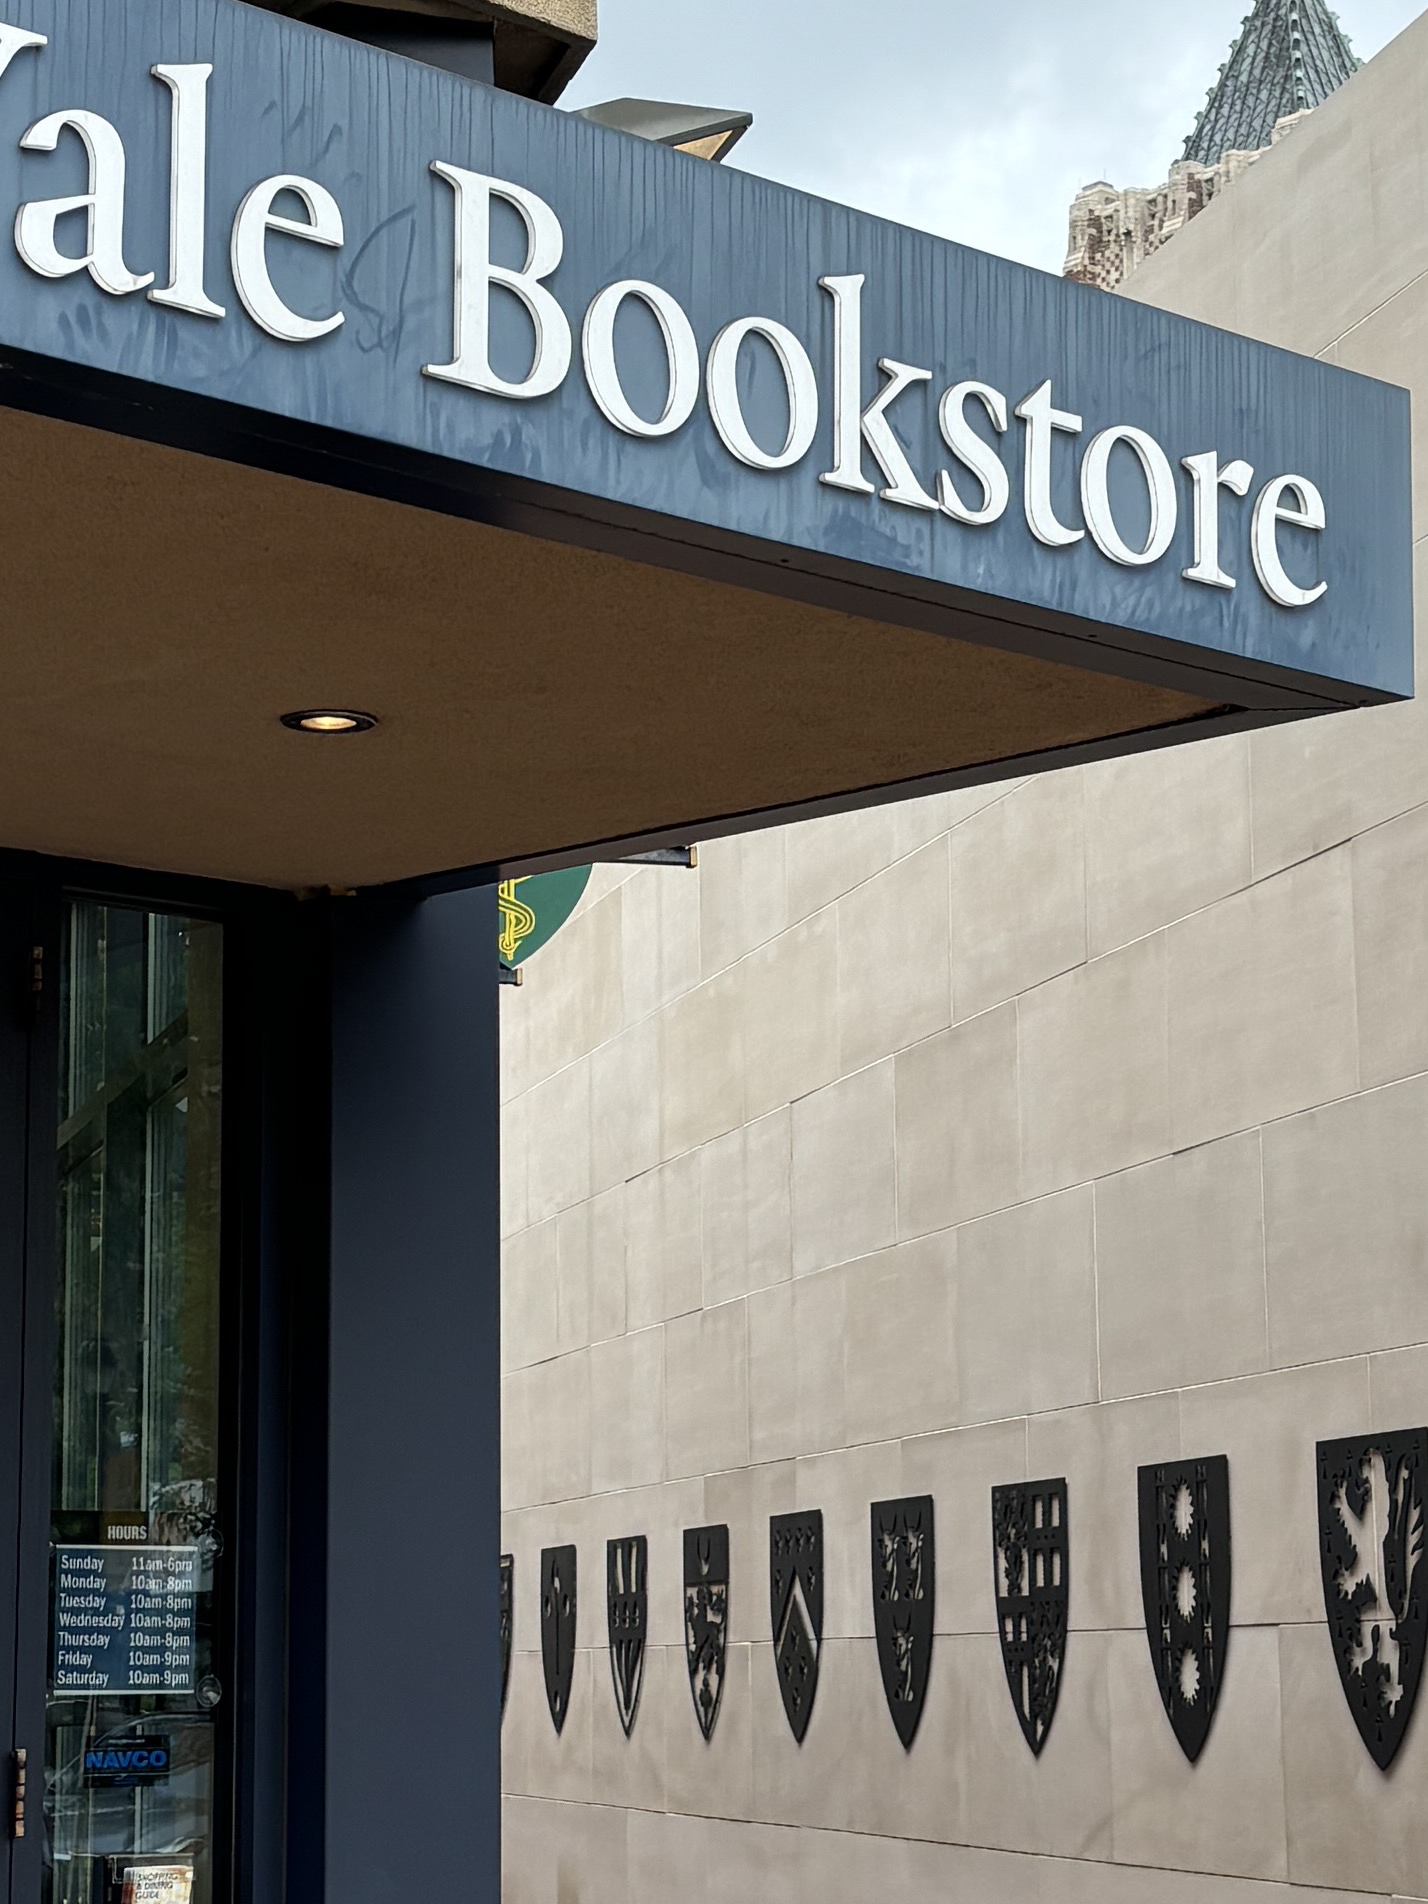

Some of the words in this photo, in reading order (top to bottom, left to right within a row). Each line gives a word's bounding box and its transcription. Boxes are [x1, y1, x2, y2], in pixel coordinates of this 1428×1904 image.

[424, 159, 1330, 608] Bookstore
[108, 1525, 147, 1539] HOURS
[61, 1555, 104, 1572] Sunday
[60, 1574, 106, 1592] Monday
[60, 1593, 106, 1611] Tuesday
[59, 1612, 125, 1630] Wednesday
[58, 1632, 110, 1649] Thursday
[58, 1651, 93, 1669] Friday
[56, 1670, 109, 1688] Saturday
[86, 1751, 166, 1769] NAVCO
